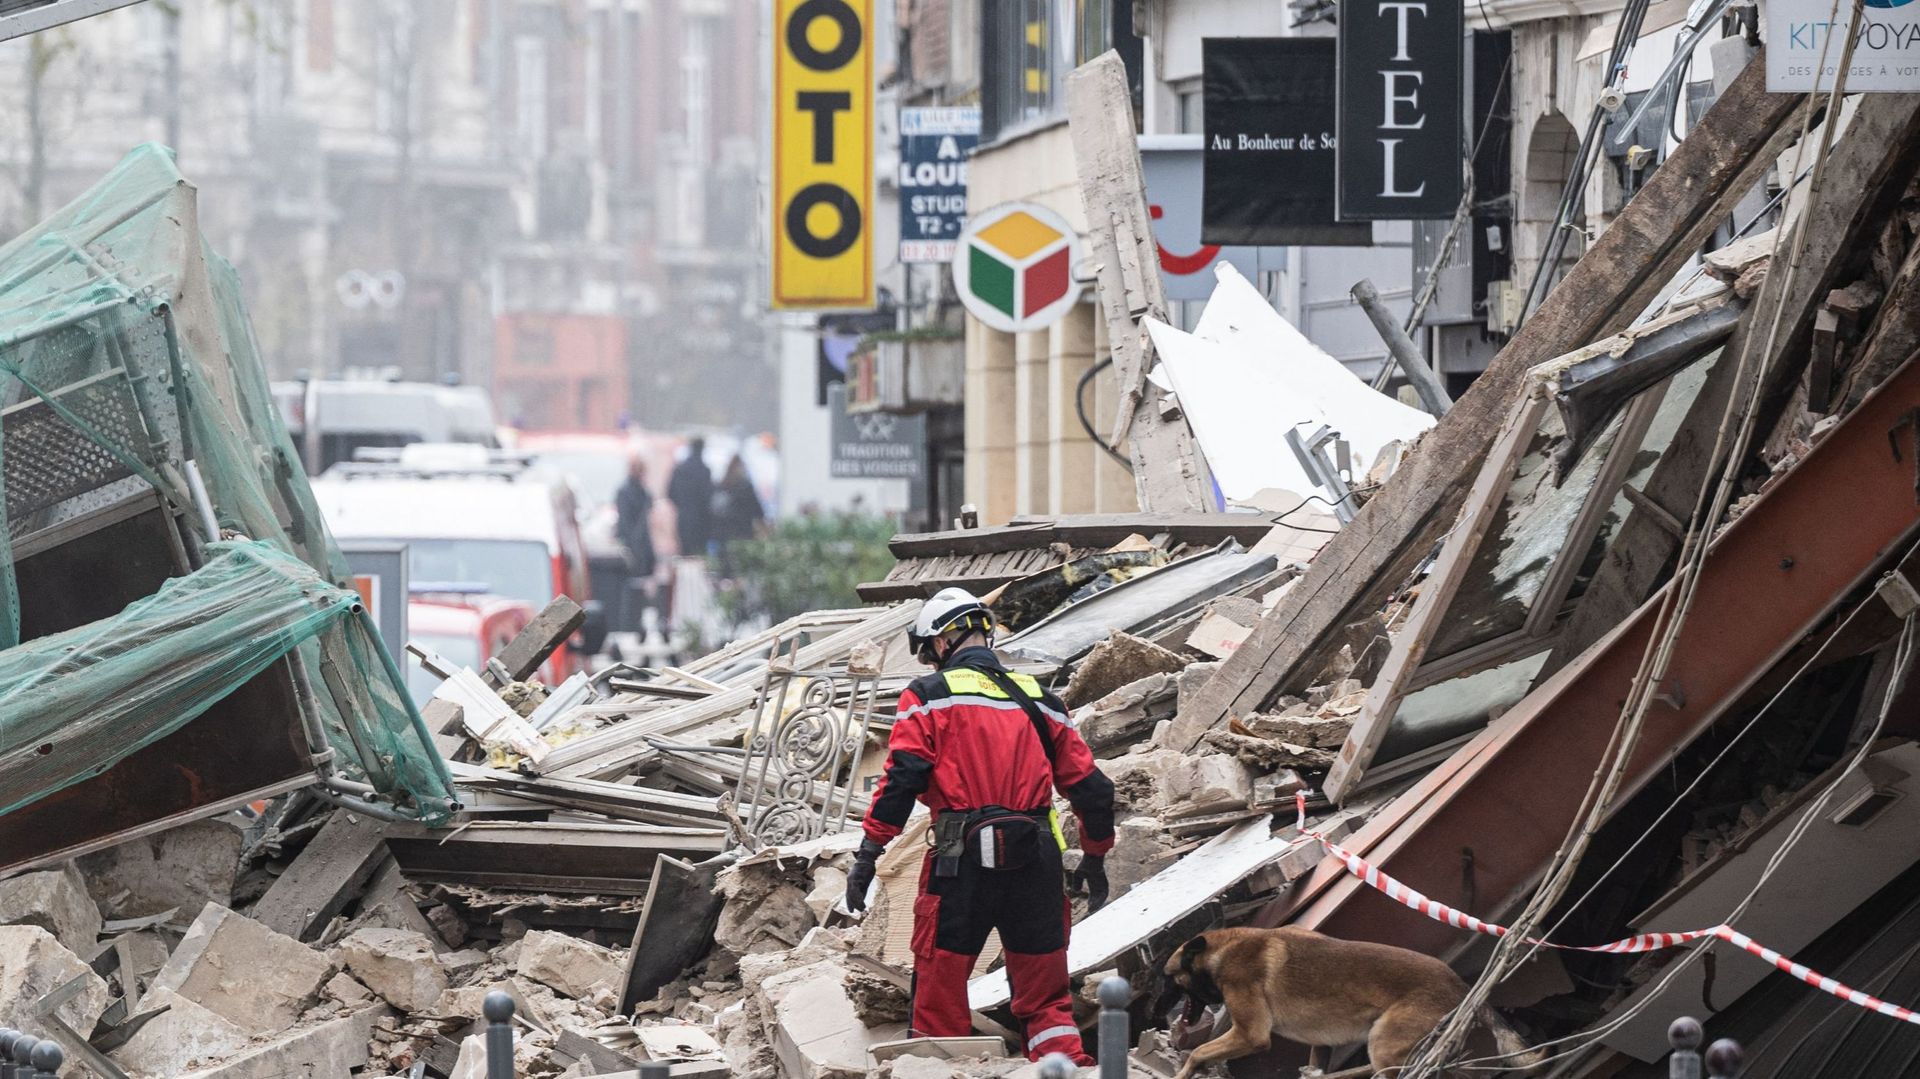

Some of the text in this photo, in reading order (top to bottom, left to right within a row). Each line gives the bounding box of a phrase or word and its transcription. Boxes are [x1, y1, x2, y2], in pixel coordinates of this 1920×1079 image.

[1790, 23, 1837, 50] KIT
[1788, 66, 1812, 76] DES
[1378, 3, 1428, 198] TEL
[786, 0, 863, 259] OTO
[1211, 133, 1232, 150] Au
[1237, 132, 1295, 150] Bonheur
[1299, 132, 1316, 150] de
[937, 135, 959, 160] A
